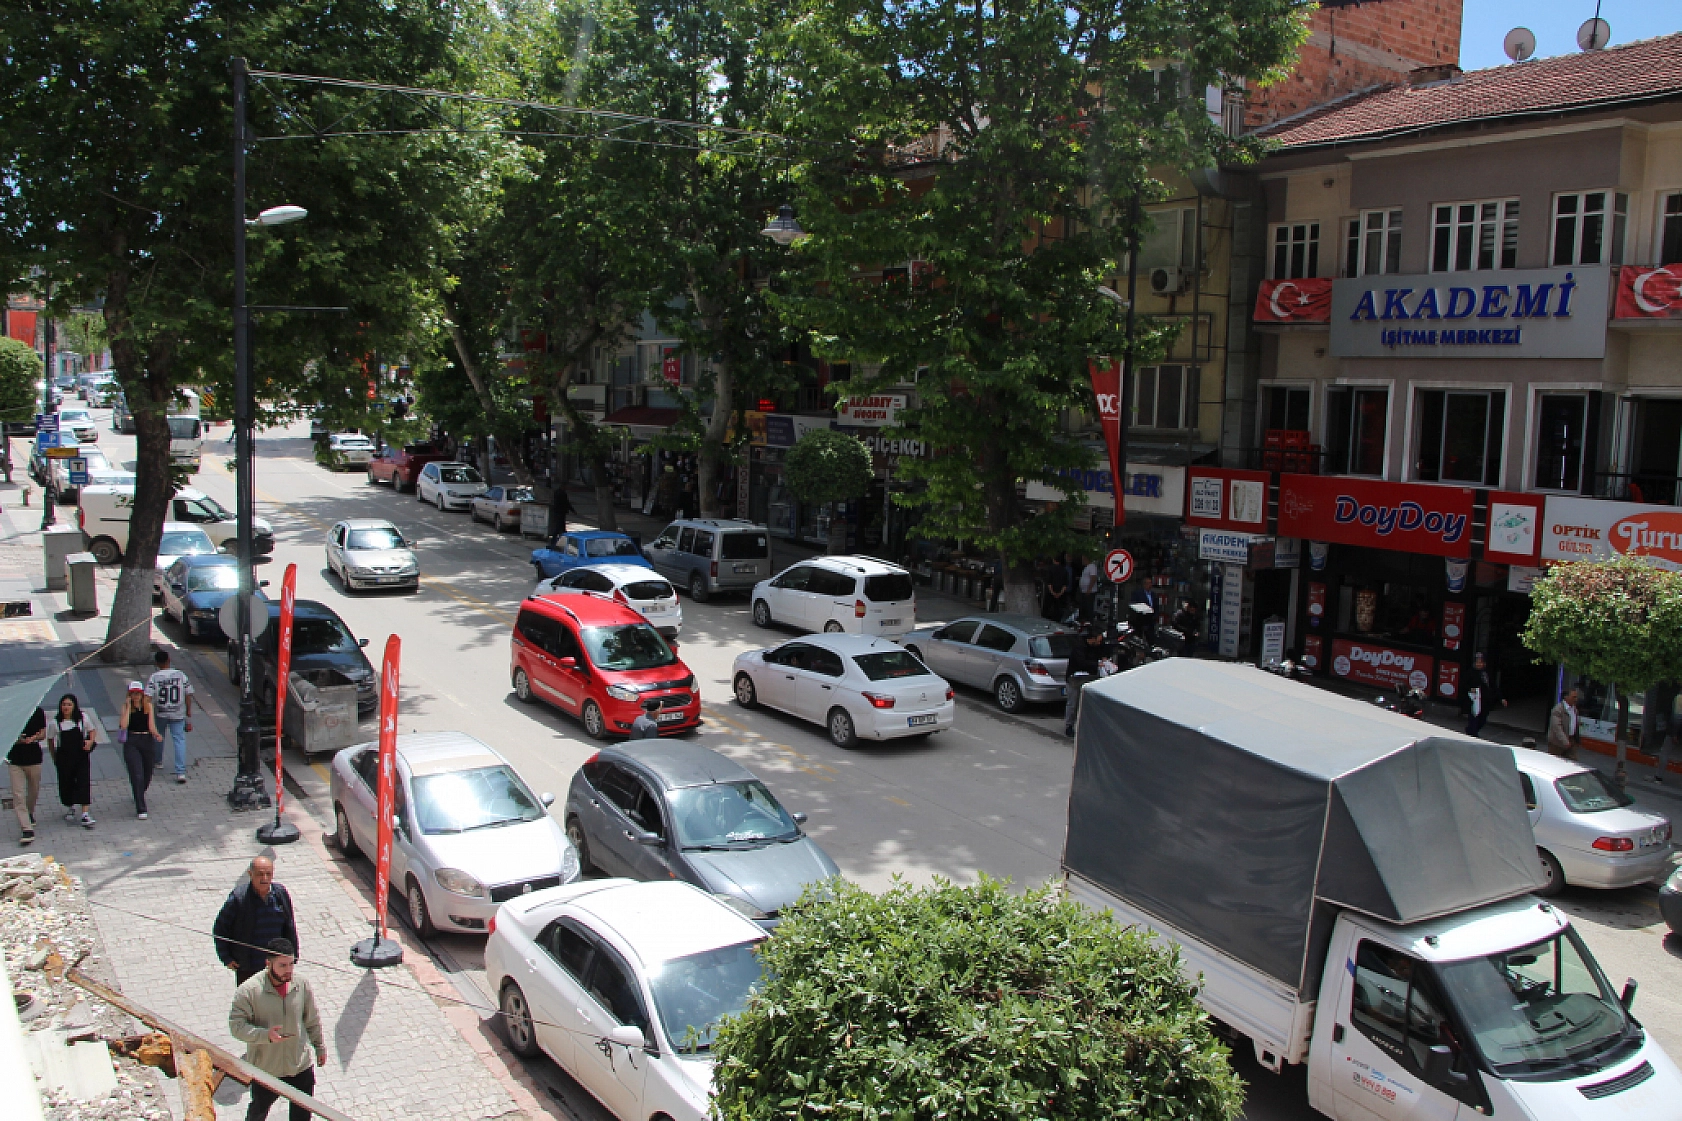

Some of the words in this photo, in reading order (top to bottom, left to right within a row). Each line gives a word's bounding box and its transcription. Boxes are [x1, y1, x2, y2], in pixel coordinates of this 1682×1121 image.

[1350, 272, 1578, 321] AKADEMİ
[1381, 327, 1436, 348] İŞİTME
[1440, 325, 1523, 346] MERKEZİ
[73, 462, 82, 471] T
[1334, 495, 1467, 543] DoyDoy
[1552, 524, 1601, 540] OPTİK
[1350, 646, 1415, 671] DoyDoy
[158, 686, 180, 704] 90
